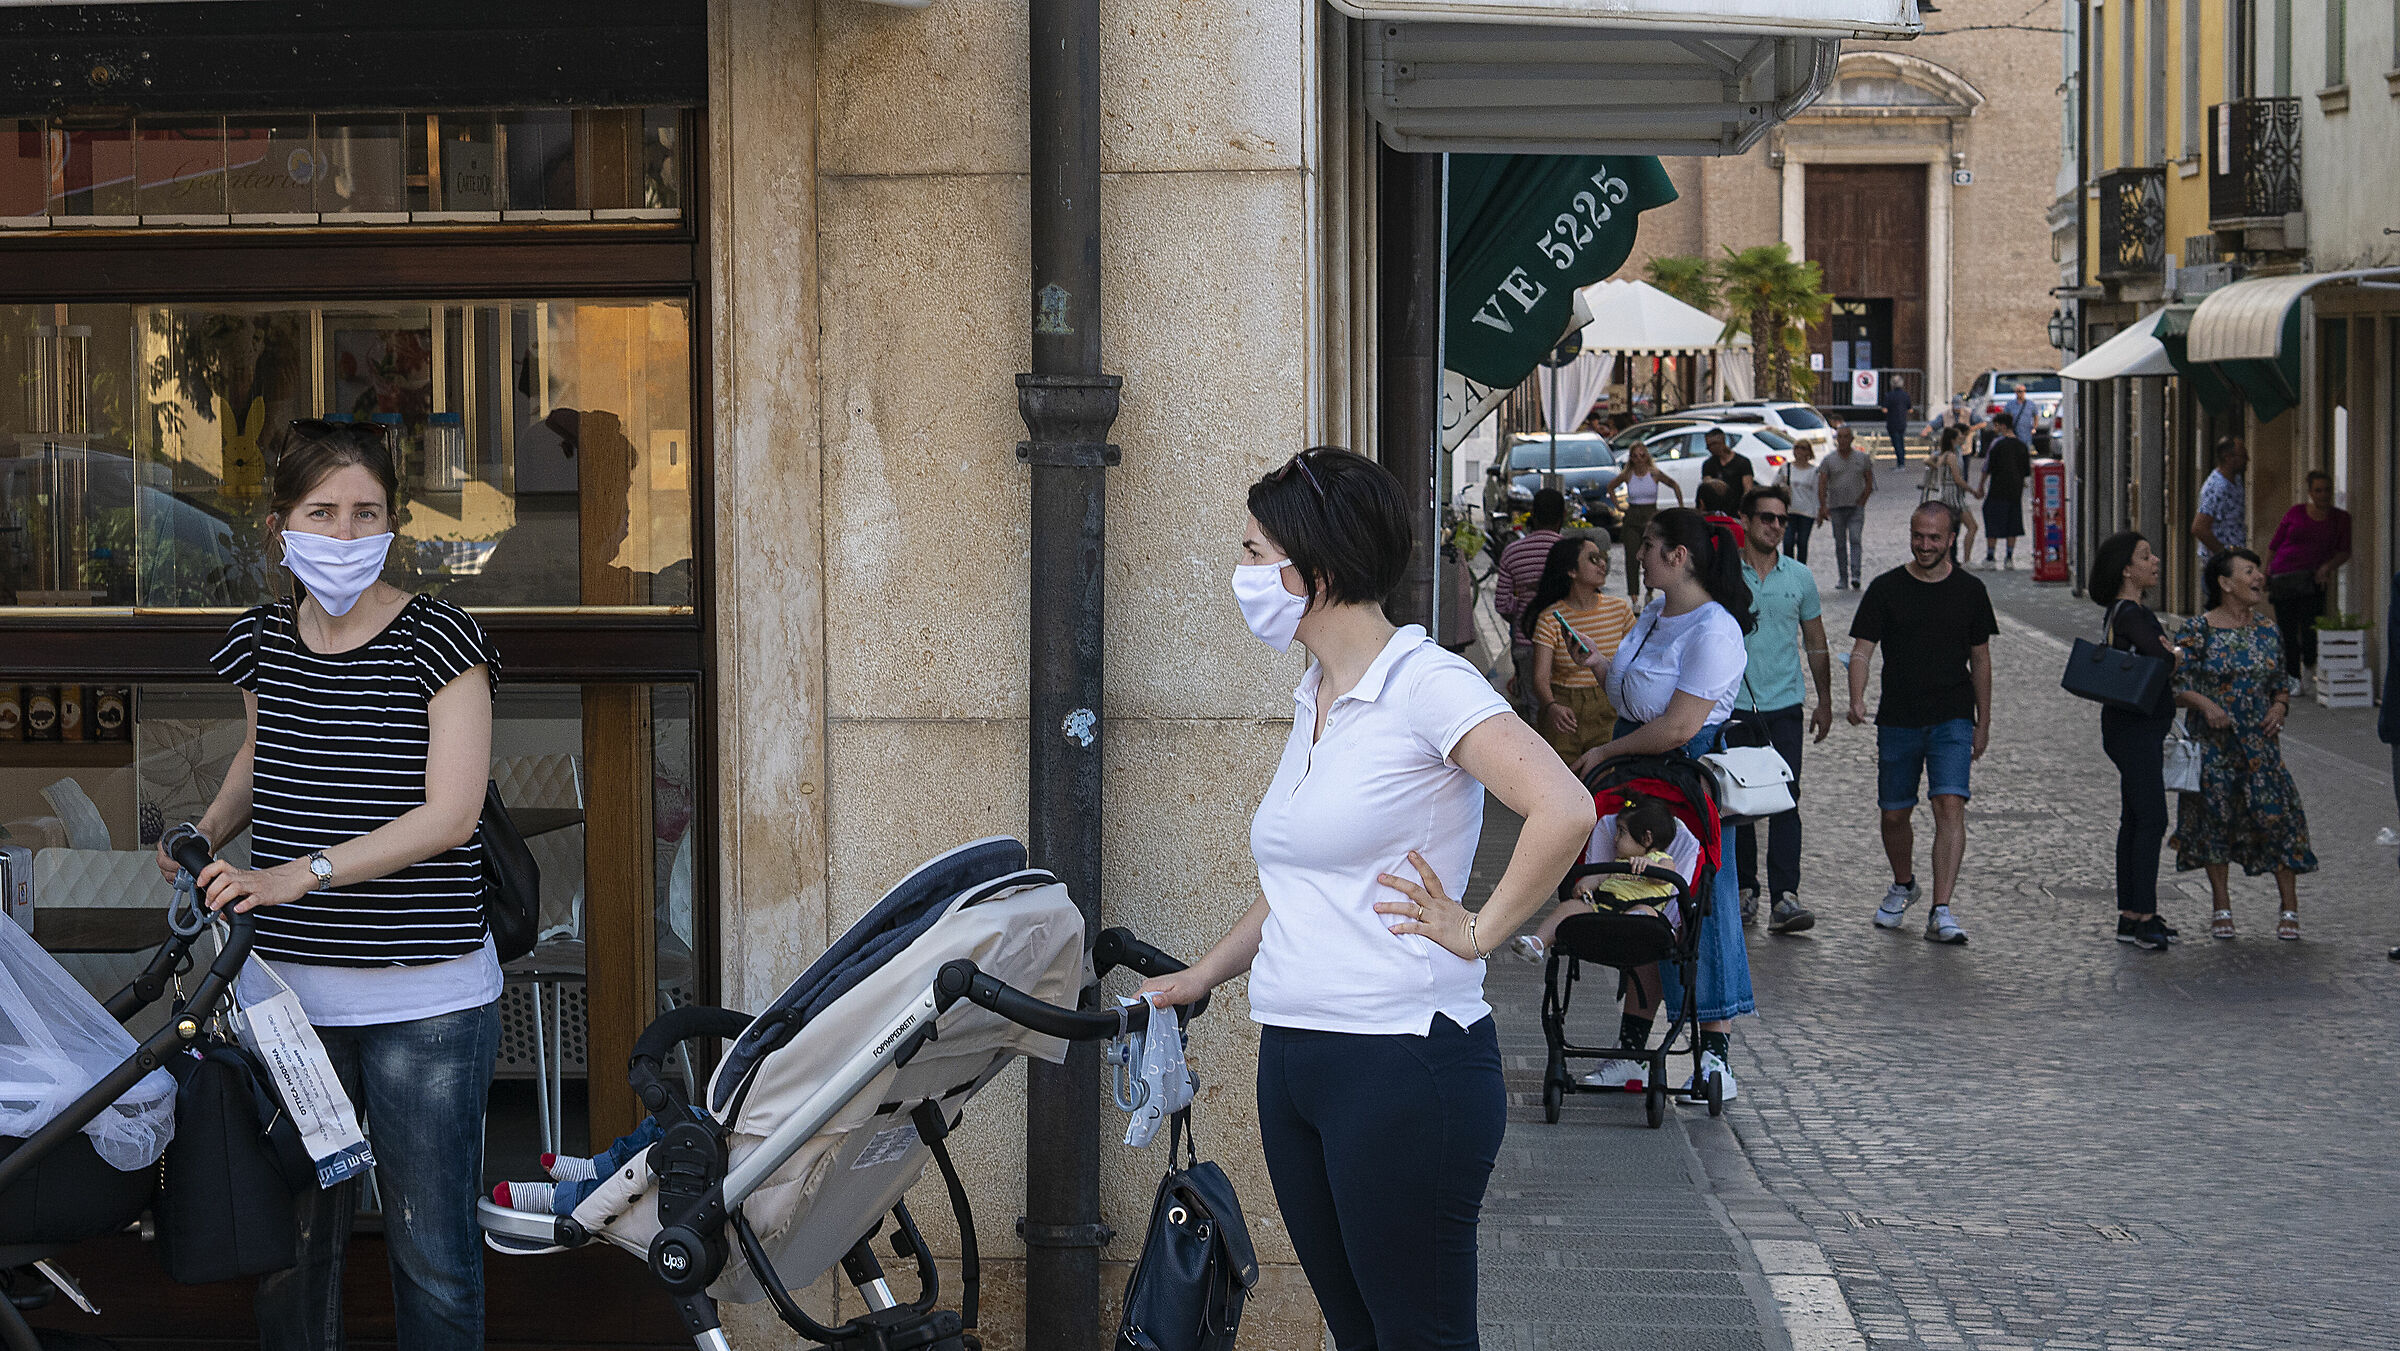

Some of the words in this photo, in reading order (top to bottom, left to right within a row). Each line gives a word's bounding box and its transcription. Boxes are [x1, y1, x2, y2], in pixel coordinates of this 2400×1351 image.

[1471, 265, 1548, 333] VE
[1536, 164, 1629, 270] 5225
[270, 1048, 293, 1086] MODERNA
[289, 1085, 307, 1115] OTTICA
